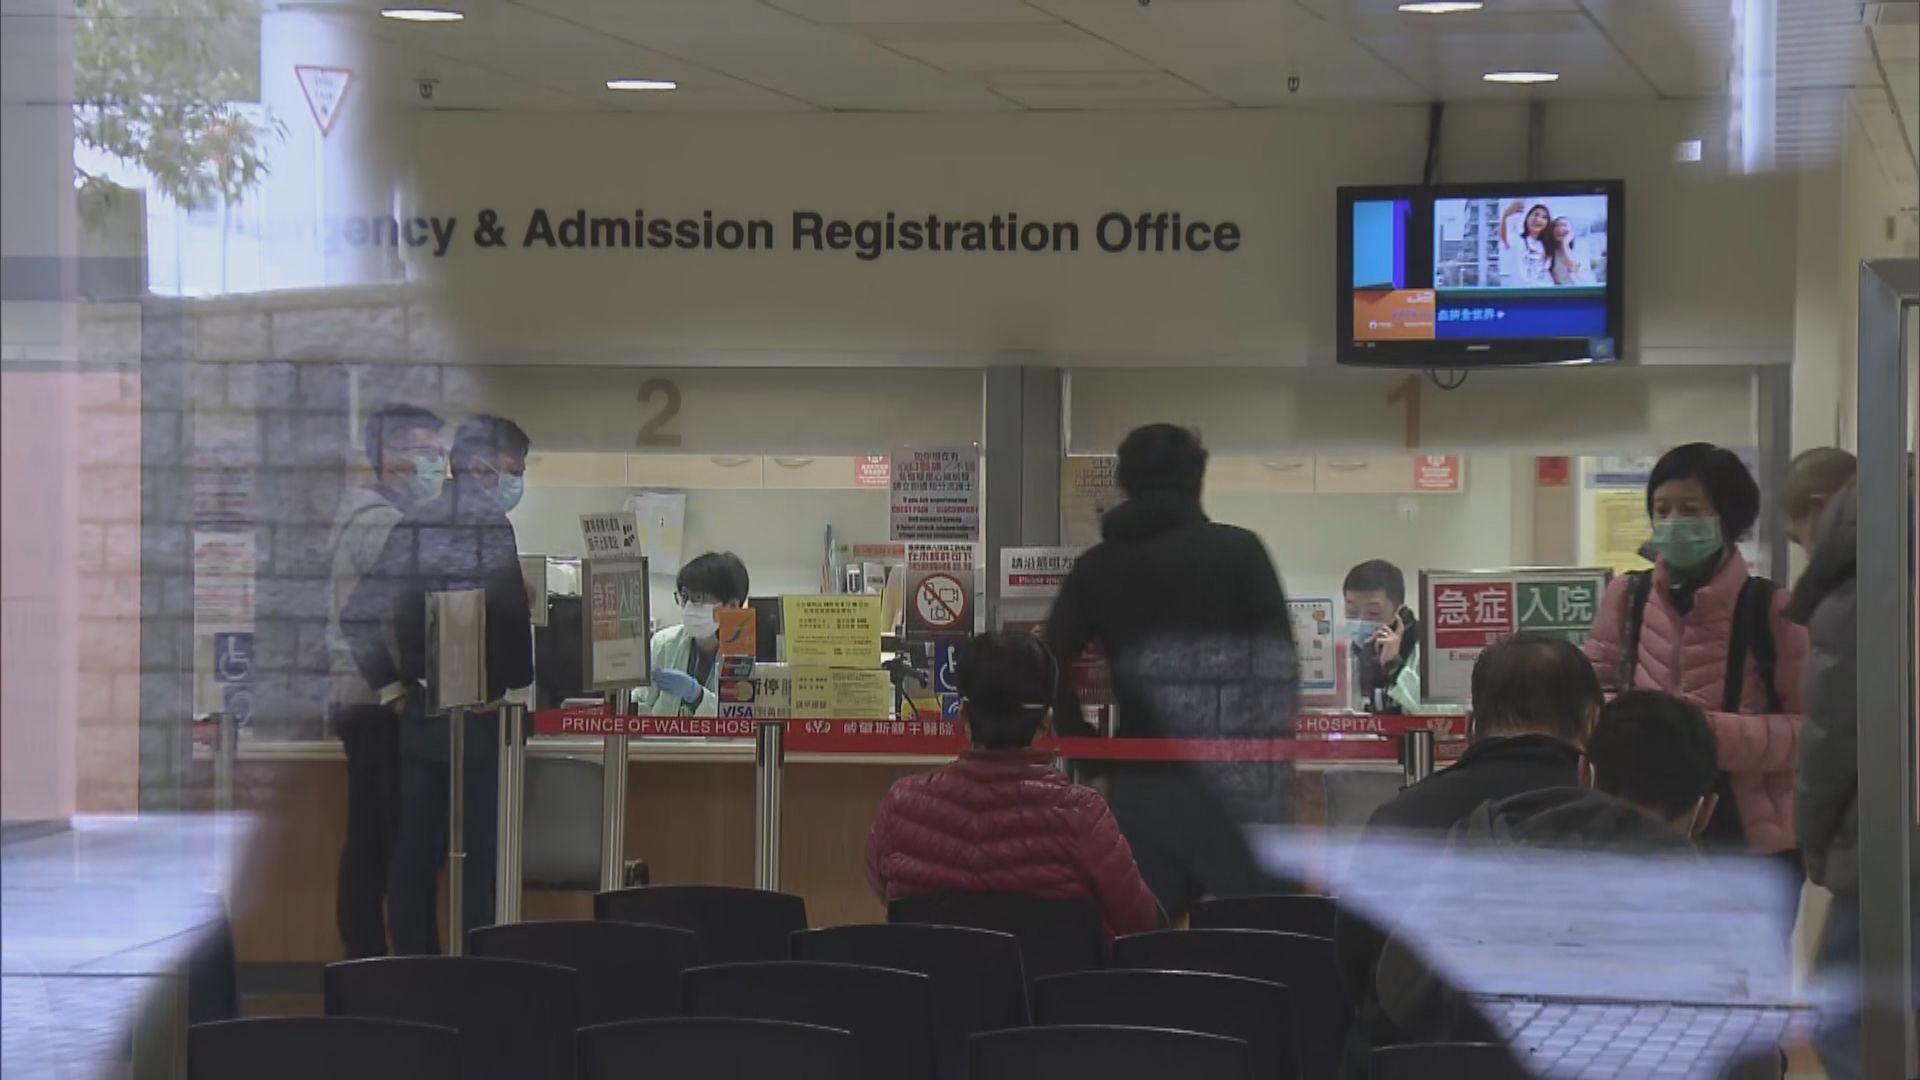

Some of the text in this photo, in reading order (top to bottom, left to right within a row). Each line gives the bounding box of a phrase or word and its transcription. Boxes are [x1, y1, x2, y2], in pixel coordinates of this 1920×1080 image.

[473, 208, 507, 248] &
[522, 208, 774, 250] Admission
[792, 211, 1080, 262] Registration
[1096, 212, 1242, 253] Office
[636, 379, 682, 447] 2
[1387, 374, 1421, 449] 1
[1437, 585, 1593, 624] 急症 入院
[562, 717, 624, 732] PRINCE
[628, 718, 650, 732] OF
[654, 719, 711, 734] WALES
[723, 706, 753, 718] VISA
[1306, 718, 1385, 732] HOSPITAL
